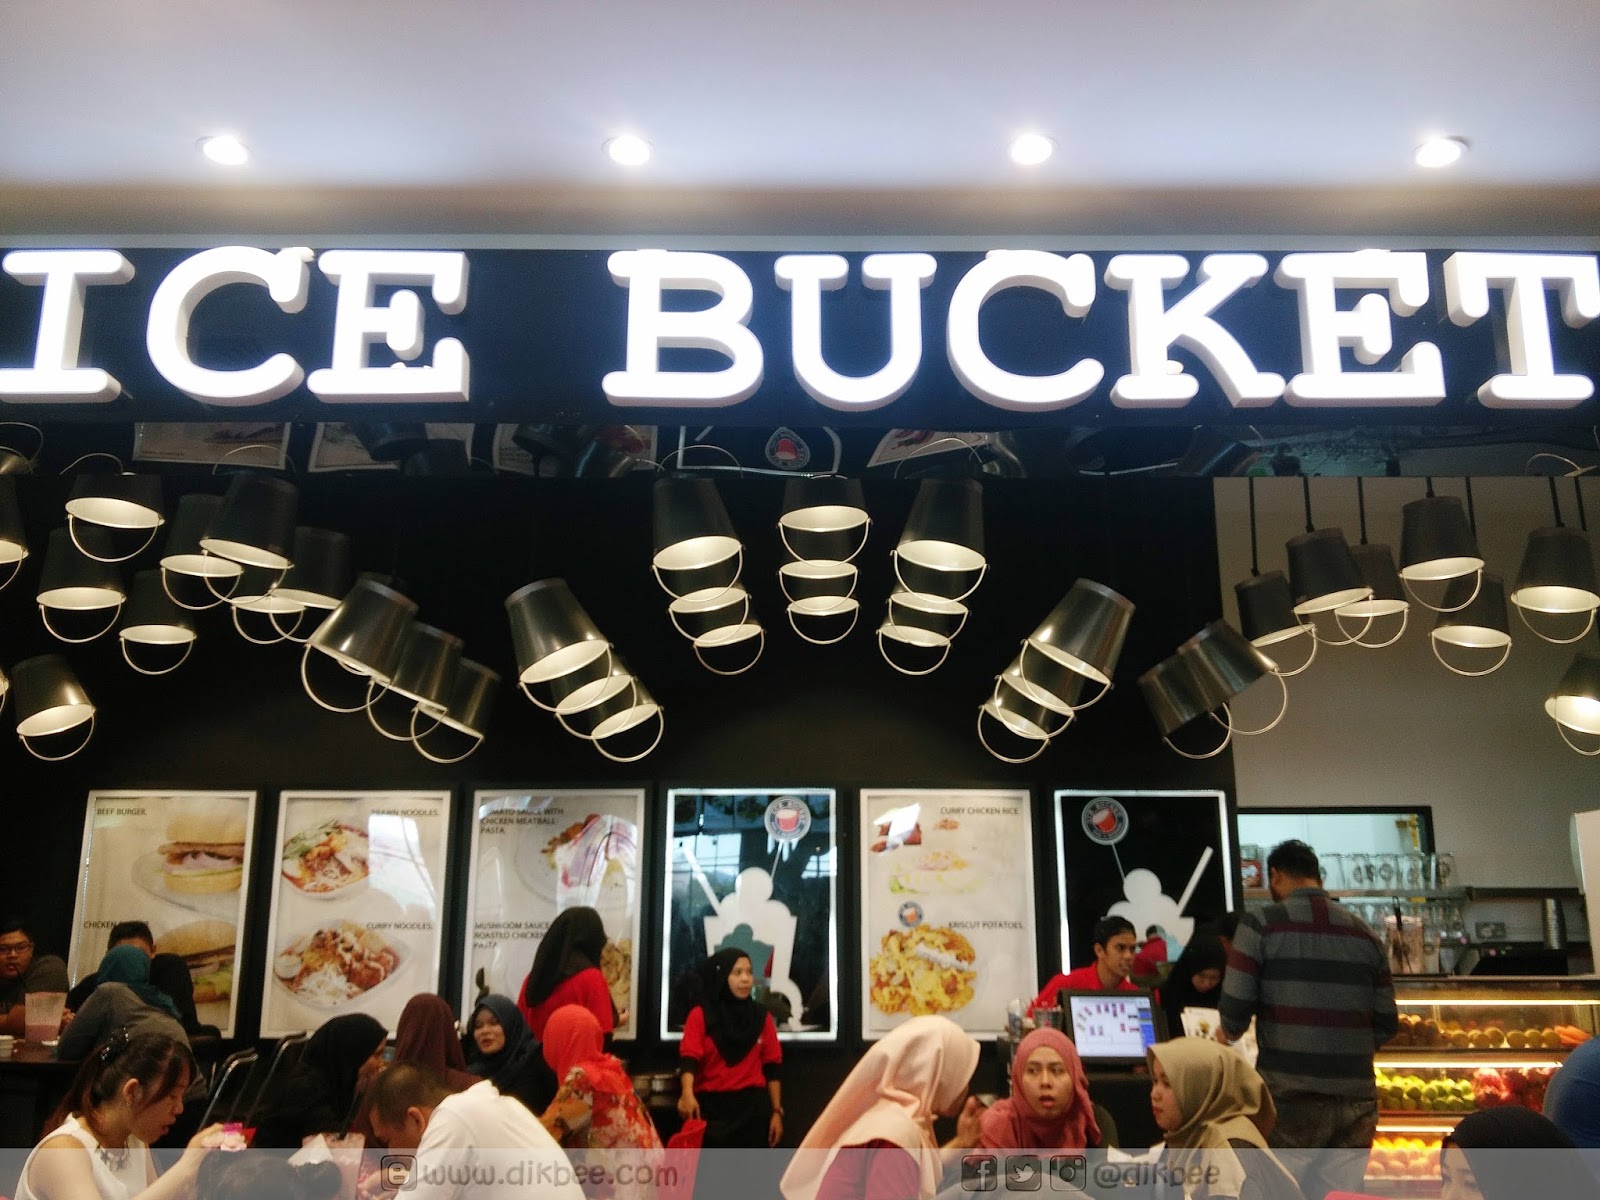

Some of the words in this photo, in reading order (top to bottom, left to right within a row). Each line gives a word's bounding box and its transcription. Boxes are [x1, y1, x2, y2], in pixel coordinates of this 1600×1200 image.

[0, 246, 470, 406] ICE
[601, 248, 1600, 411] BUCKET
[543, 807, 564, 815] WITH
[967, 807, 1001, 815] CHICKEN
[1002, 807, 1019, 815] RICE
[480, 817, 514, 825] CHICKEN
[516, 817, 556, 825] MEATBALL
[83, 920, 117, 929] CHICKEN
[366, 921, 393, 929] CURRY
